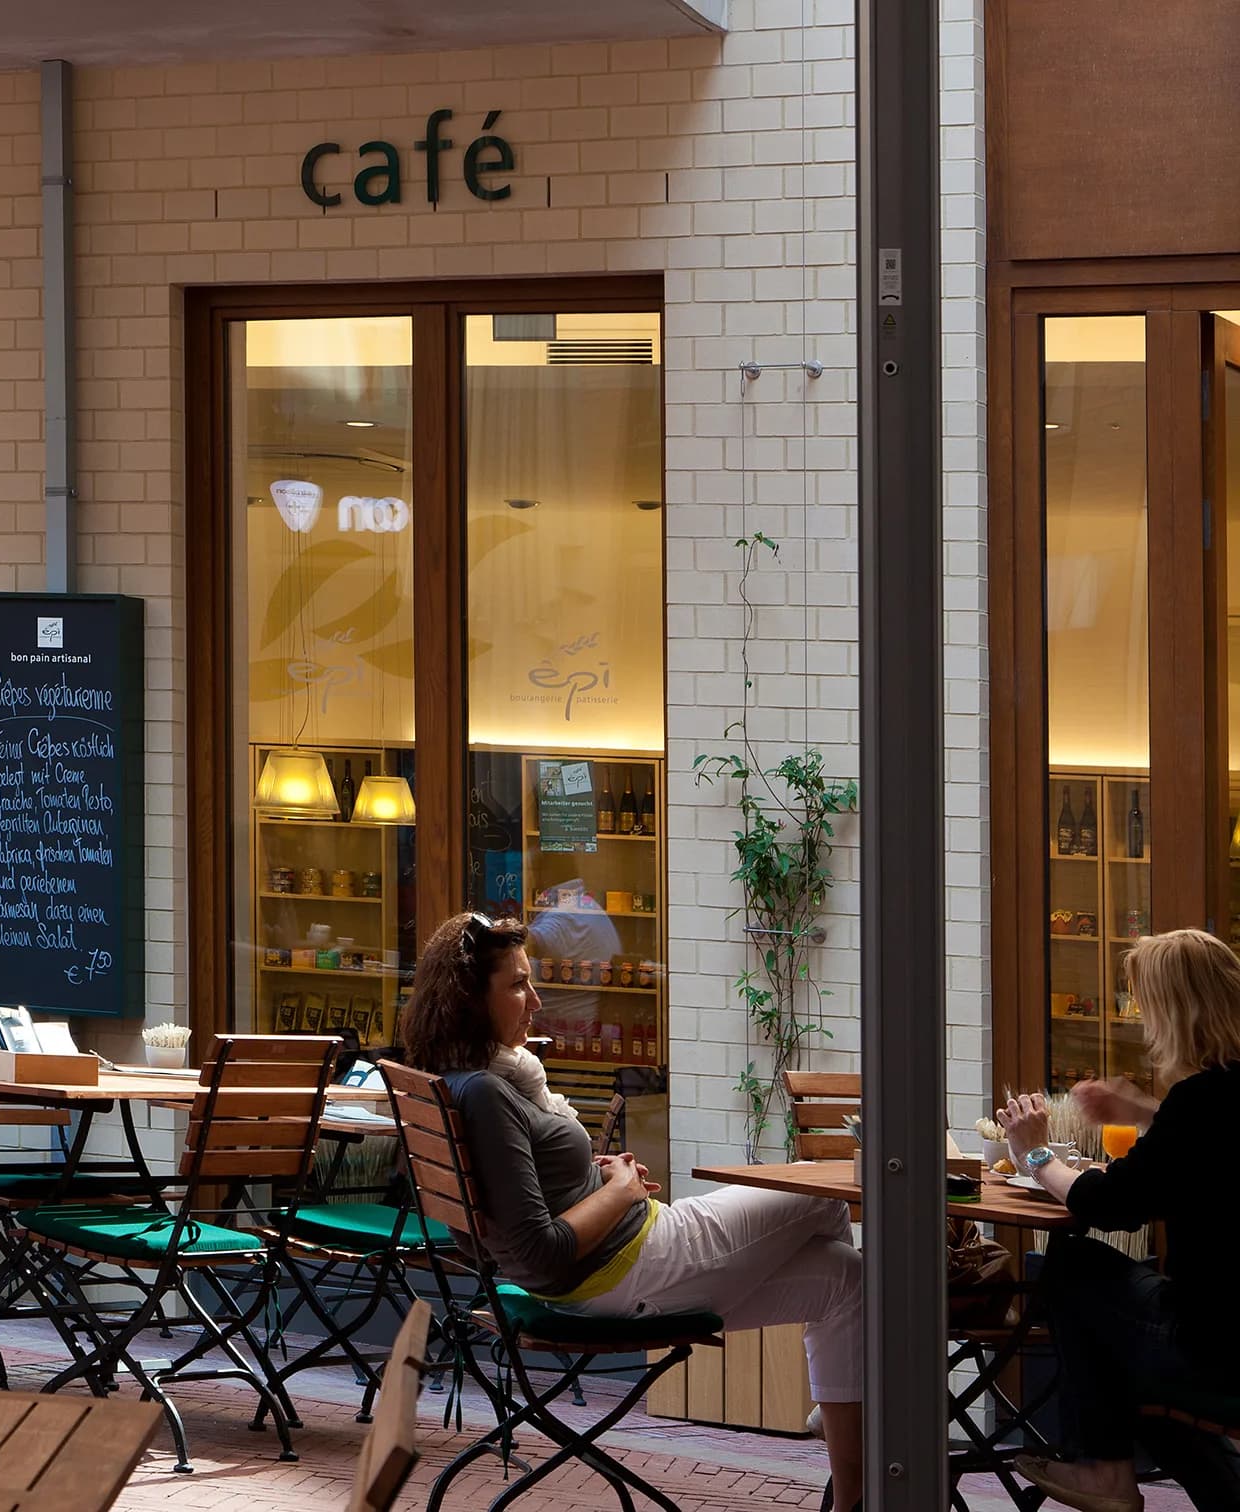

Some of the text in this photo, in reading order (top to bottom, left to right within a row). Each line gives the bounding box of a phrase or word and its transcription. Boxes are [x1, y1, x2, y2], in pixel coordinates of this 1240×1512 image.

[301, 109, 514, 206] café
[10, 652, 91, 664] bon pain artisanal
[510, 693, 563, 704] boulangerie
[31, 762, 49, 784] mit
[36, 786, 81, 811] Tomaten
[45, 895, 74, 921] dazu
[78, 903, 110, 926] einen
[64, 965, 83, 985] €
